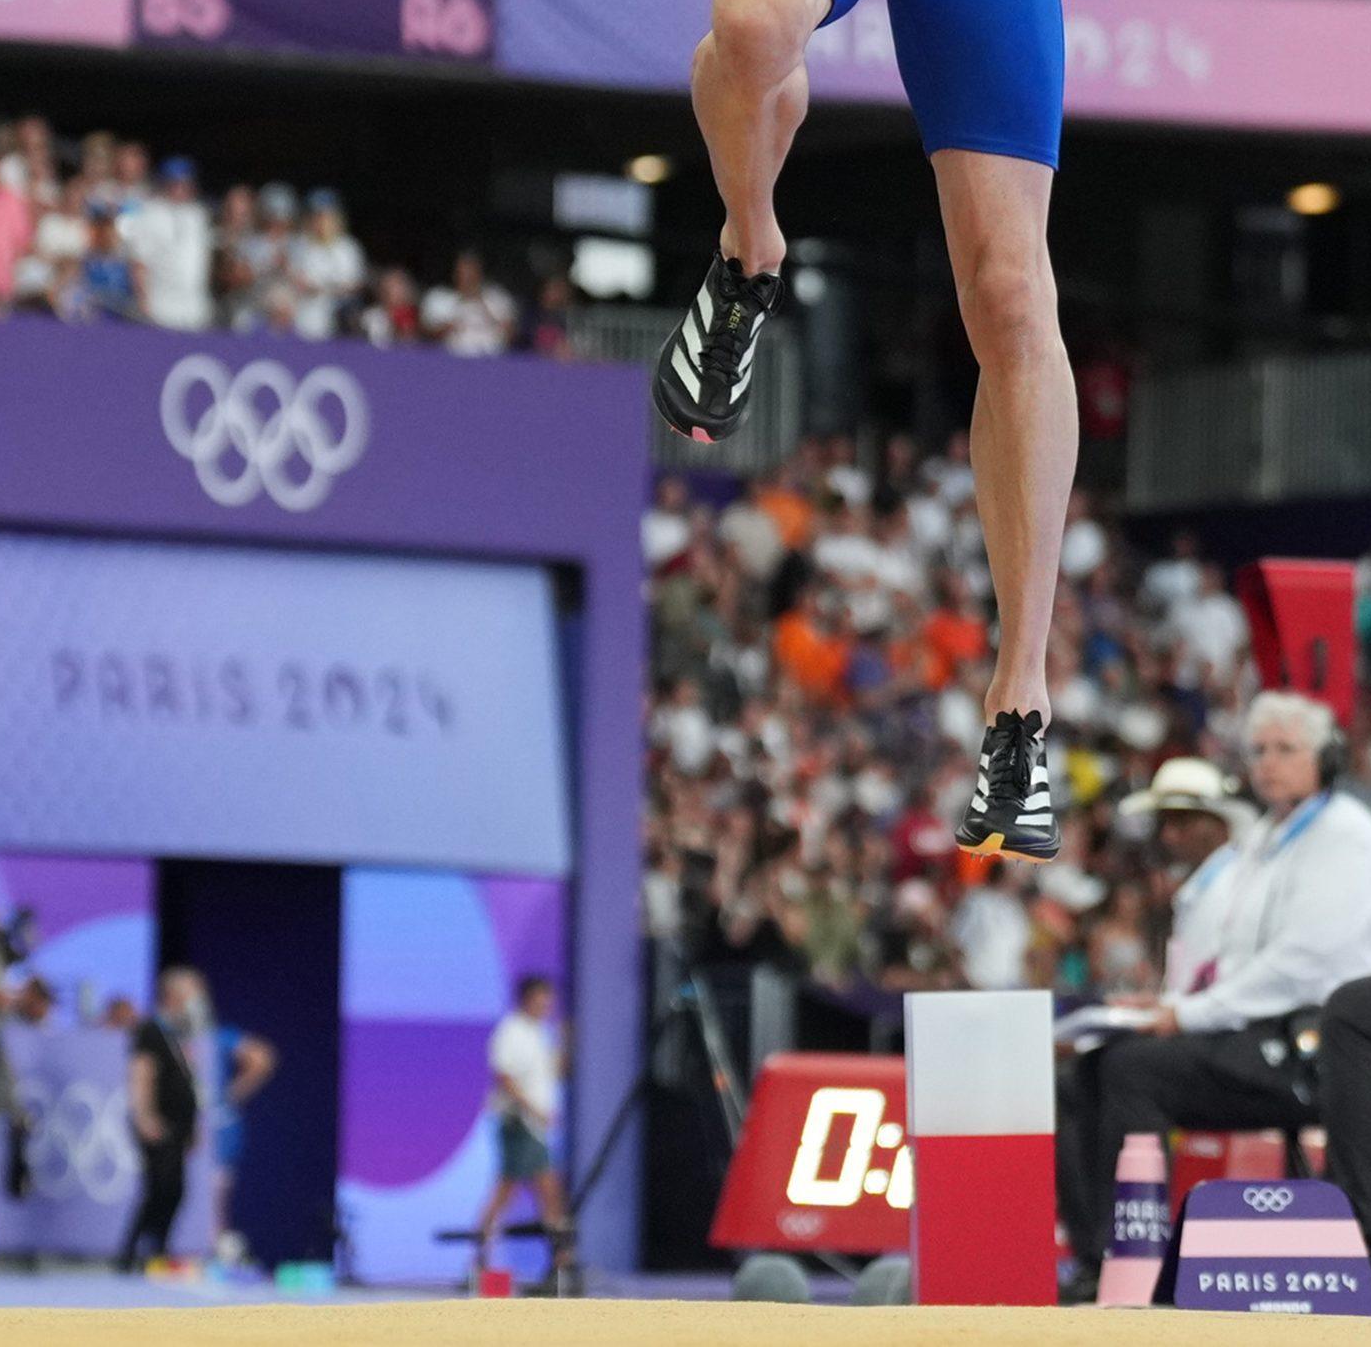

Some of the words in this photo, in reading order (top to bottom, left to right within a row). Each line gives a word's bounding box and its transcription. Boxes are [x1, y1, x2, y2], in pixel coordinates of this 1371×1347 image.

[1065, 14, 1214, 89] 024
[49, 651, 259, 726] PARIS
[277, 661, 455, 736] 2024
[1115, 1200, 1170, 1221] PARIS
[1114, 1220, 1173, 1242] 2024
[1198, 1271, 1278, 1293] PARIS
[1285, 1272, 1359, 1293] 2024
